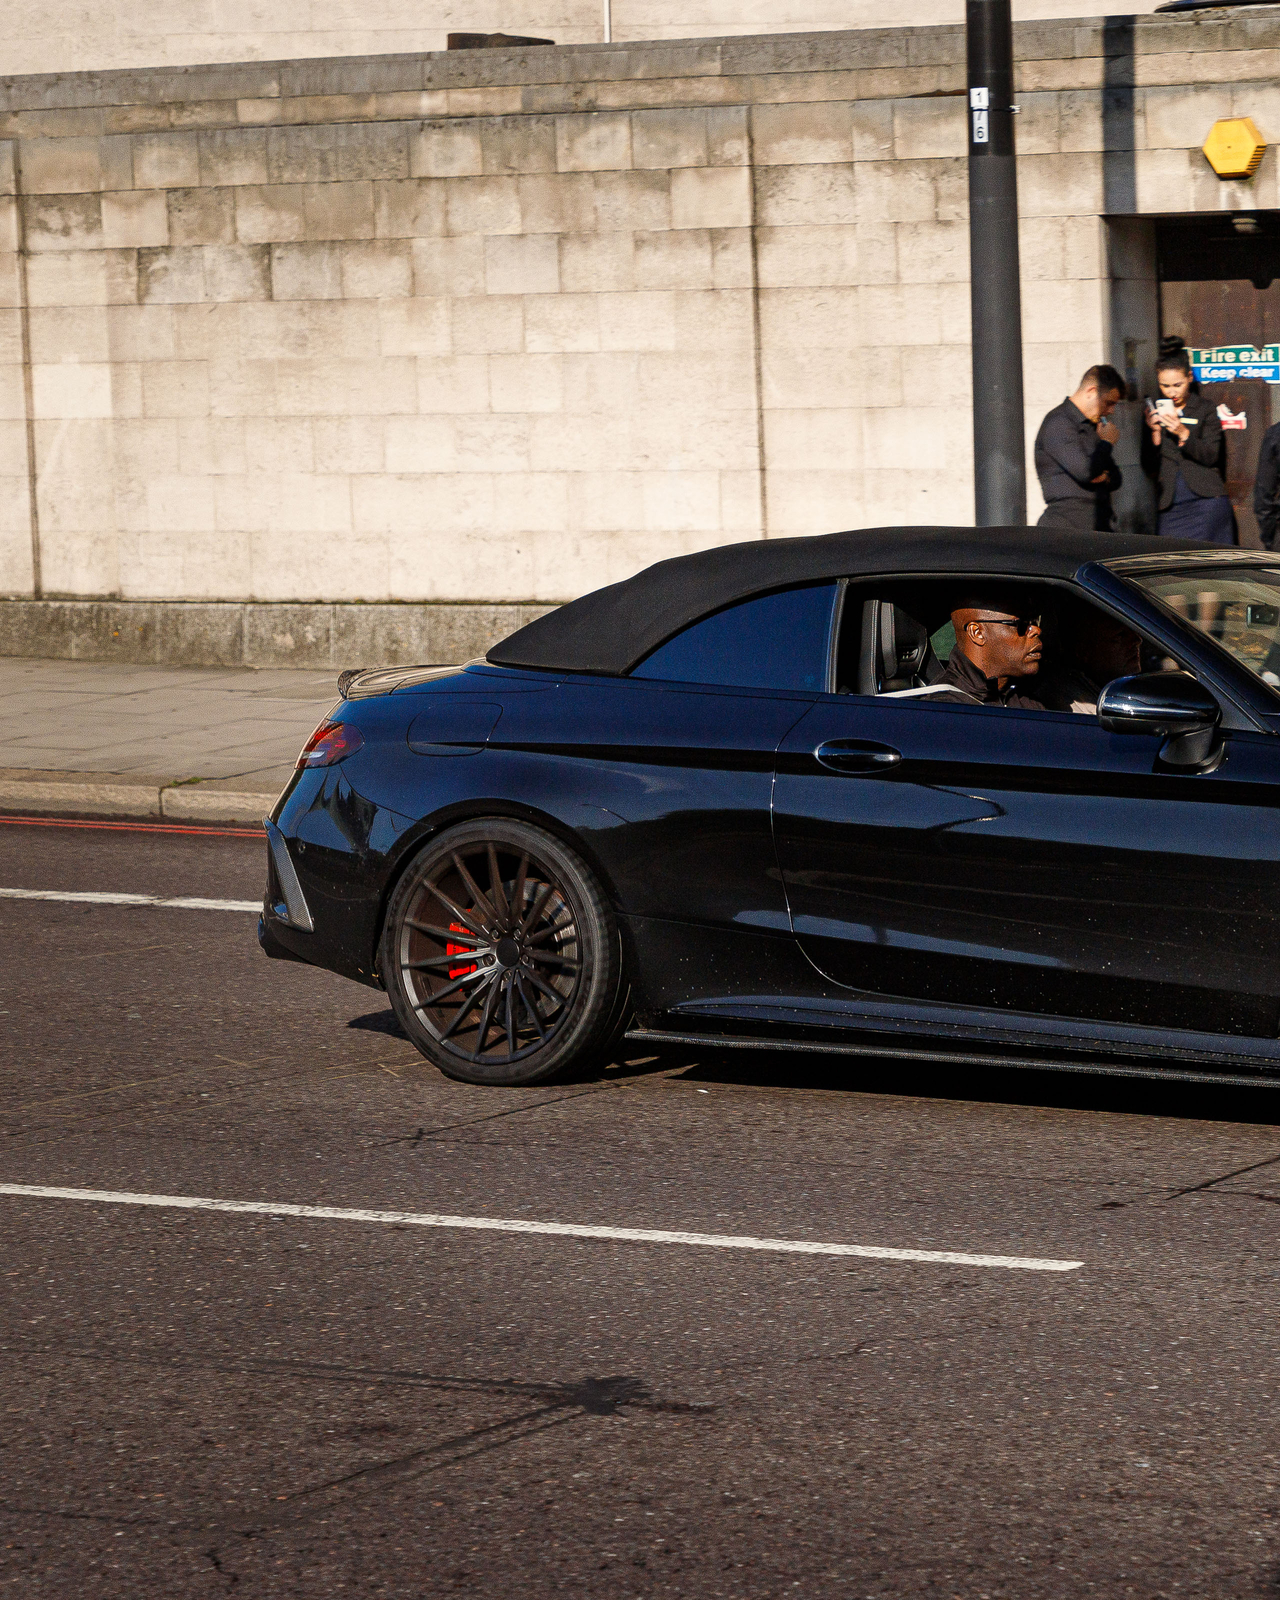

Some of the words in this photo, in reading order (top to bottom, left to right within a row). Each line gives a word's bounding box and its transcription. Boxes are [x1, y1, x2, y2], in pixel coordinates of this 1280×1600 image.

[1200, 350, 1236, 362] Fire
[1239, 348, 1275, 362] exit
[1200, 367, 1236, 381] Keep
[1239, 366, 1275, 377] clear
